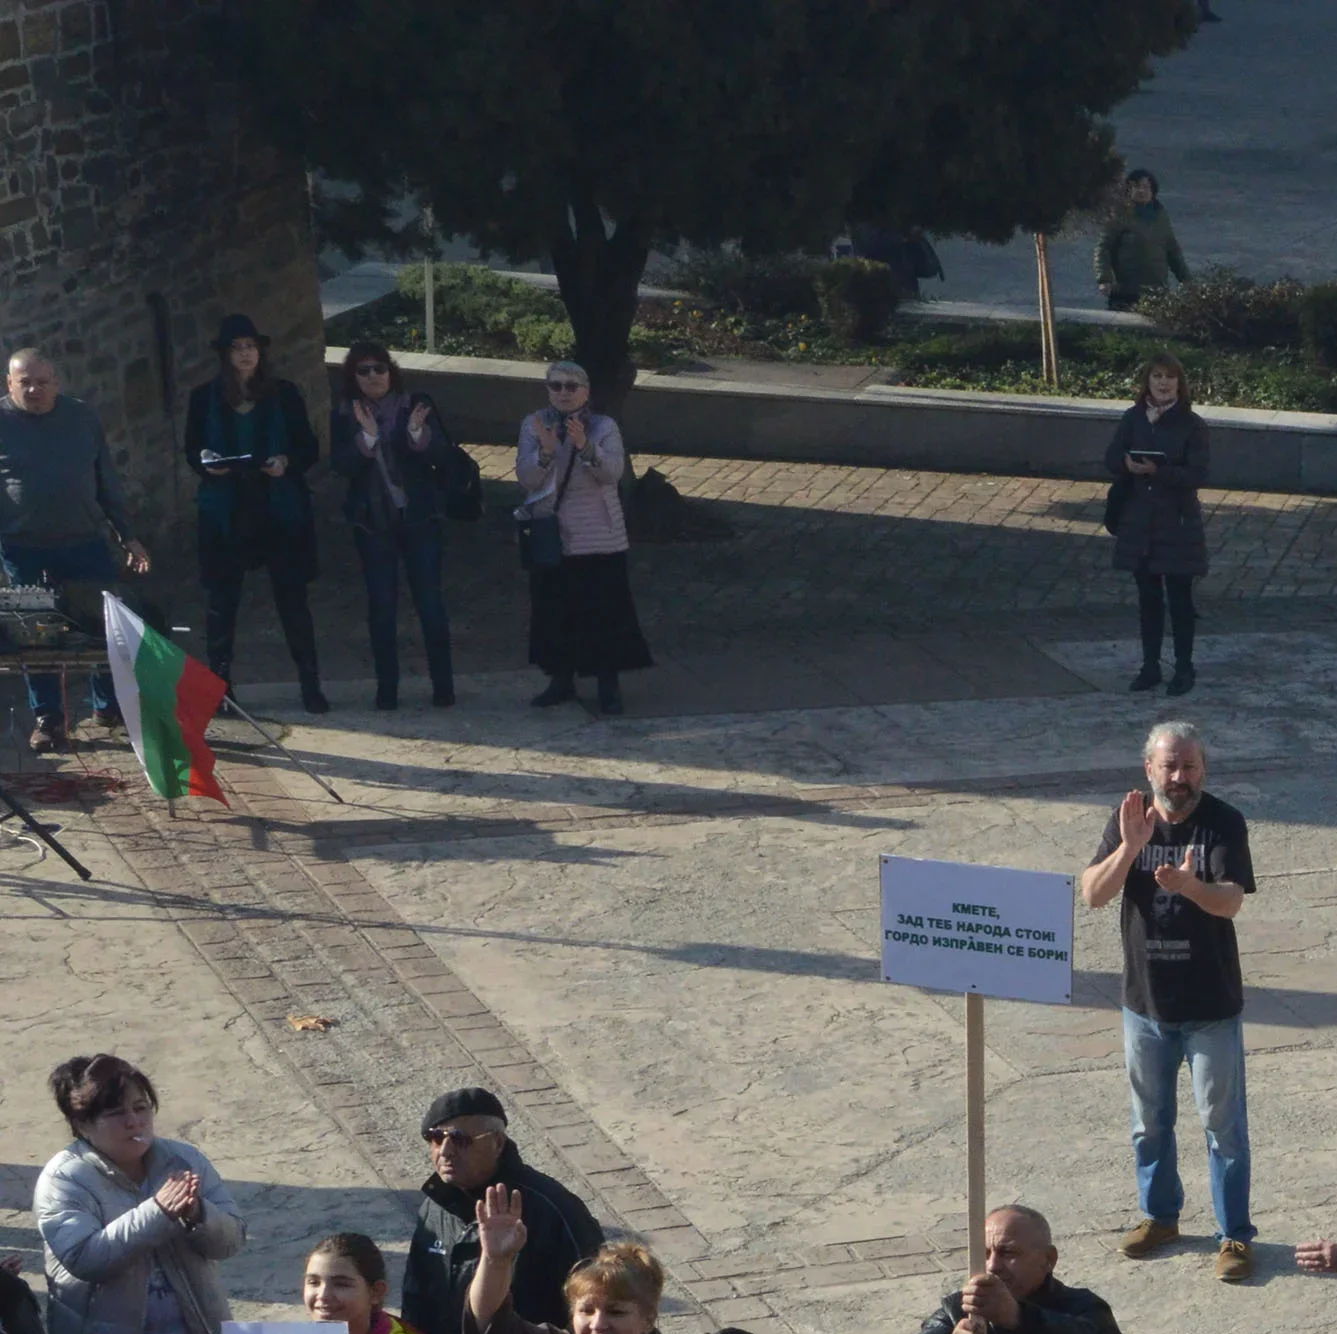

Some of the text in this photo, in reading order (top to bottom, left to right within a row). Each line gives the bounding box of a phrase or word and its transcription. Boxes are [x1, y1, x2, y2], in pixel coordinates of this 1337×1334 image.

[1135, 844, 1206, 876] OREVR
[952, 902, 1001, 920] КМЕТЕ,
[897, 914, 1056, 942] ЗАД ТЕБ НАРОДА СТОИ!
[884, 929, 1068, 962] ГОРДО ИЗПРАВЕН СЕ БОРИ!
